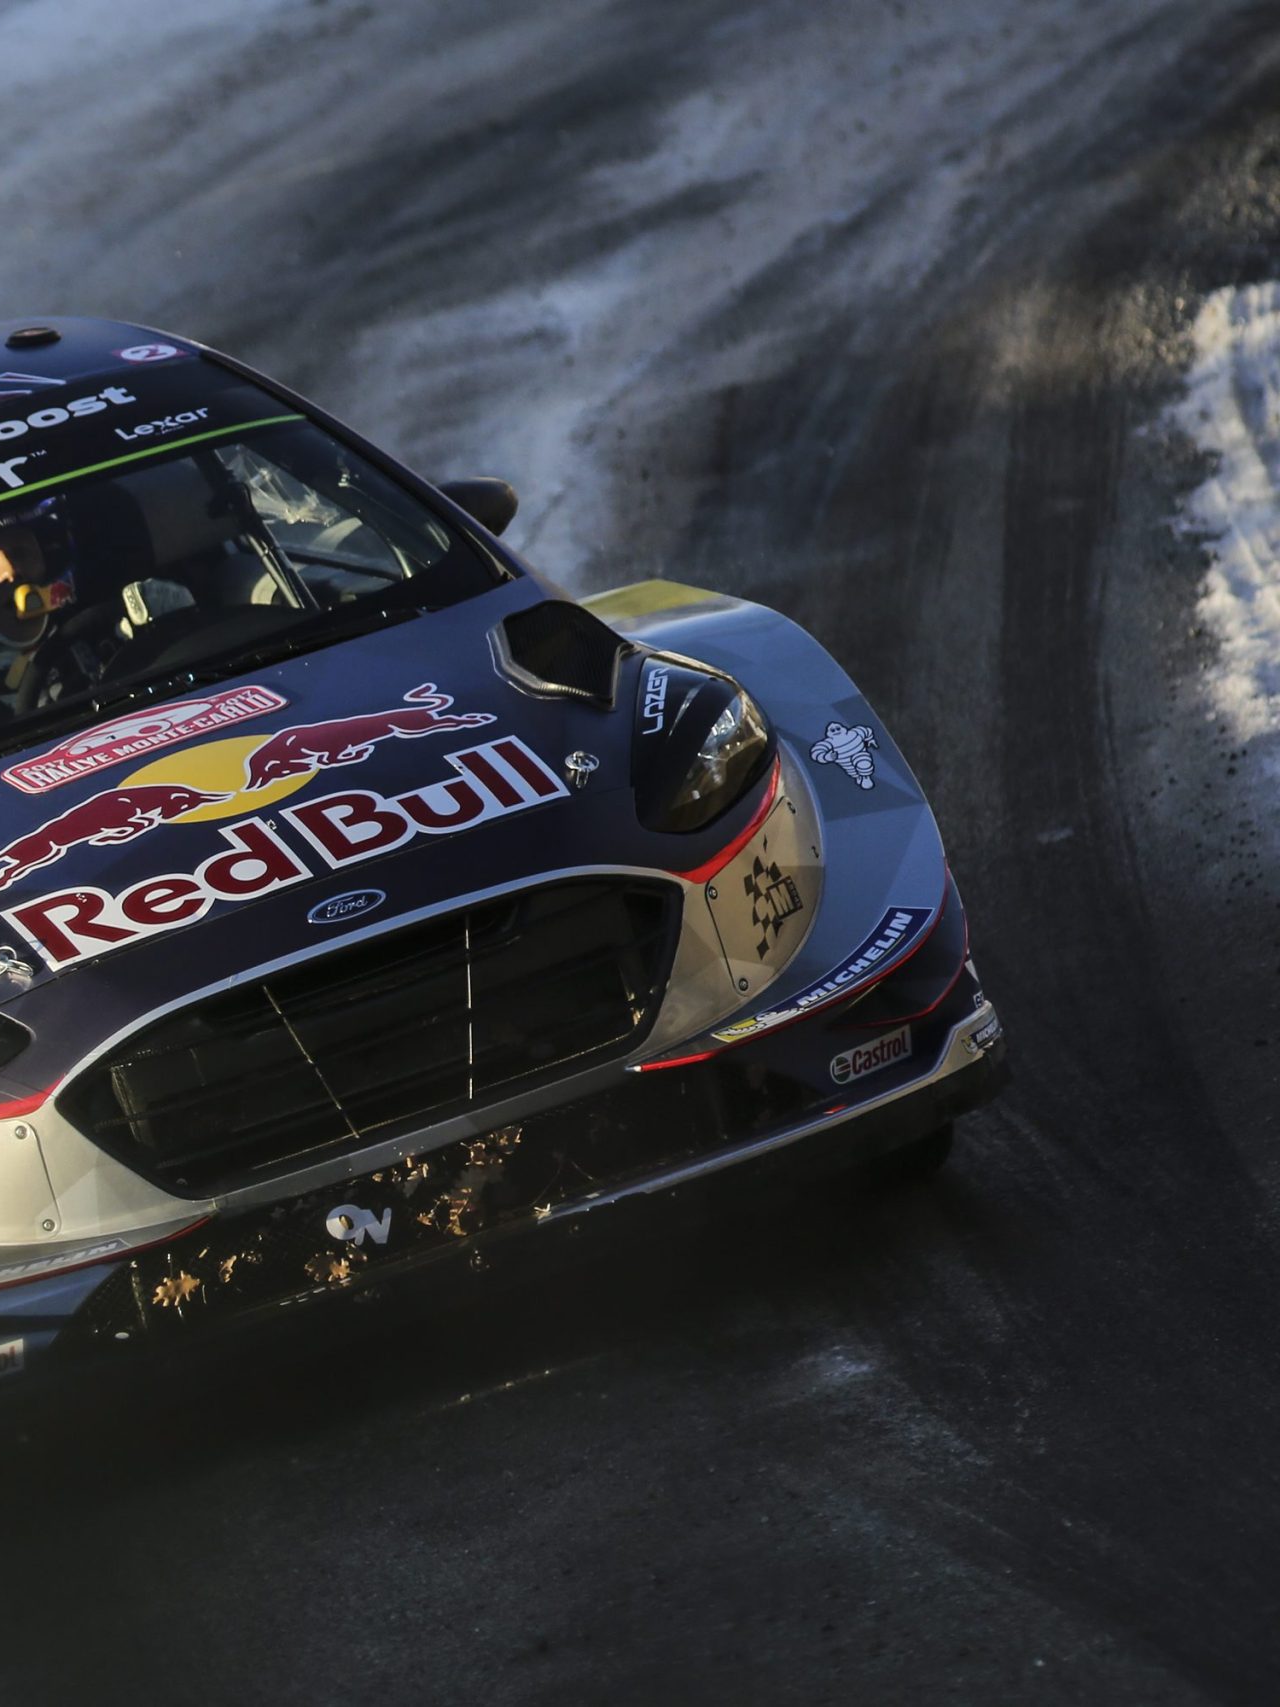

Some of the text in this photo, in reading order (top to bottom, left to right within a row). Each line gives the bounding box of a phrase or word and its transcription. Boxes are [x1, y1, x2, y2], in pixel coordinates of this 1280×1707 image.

[113, 406, 208, 440] Lexar
[641, 667, 671, 735] LAZER
[28, 753, 113, 788] RALLYE
[6, 737, 566, 966] Red Bull
[796, 911, 914, 1007] MICHELIN
[851, 1030, 908, 1076] Castrol
